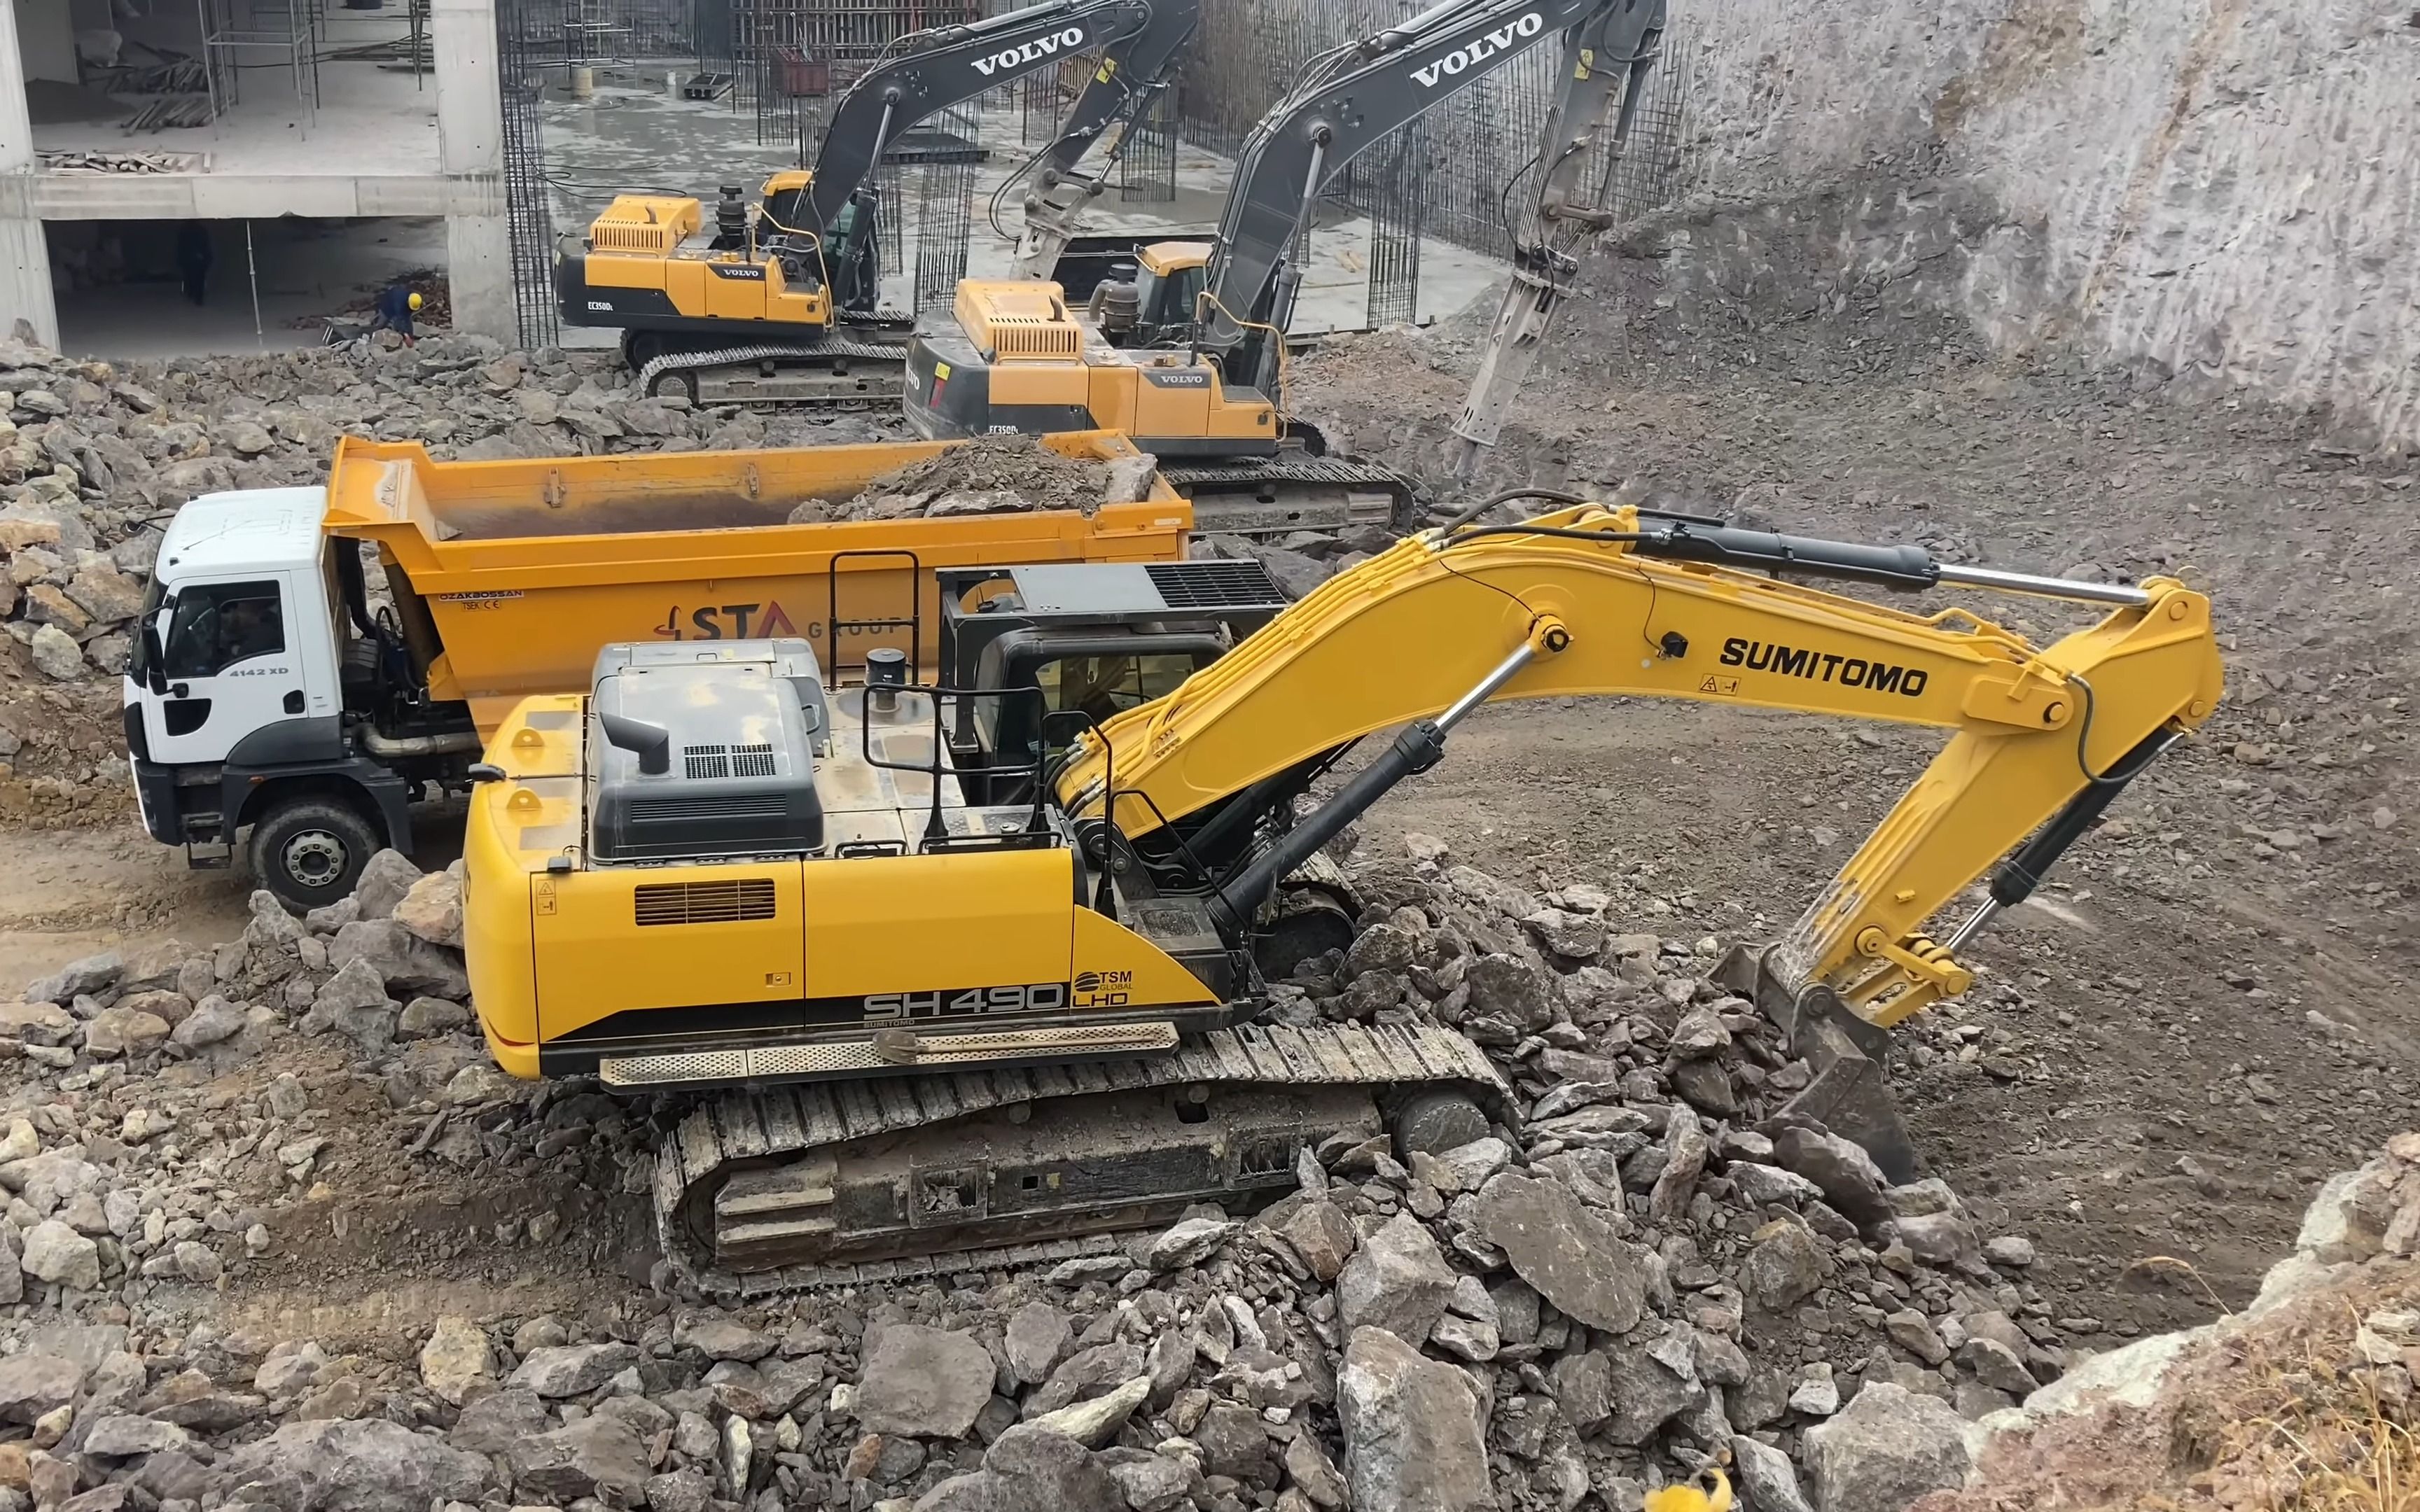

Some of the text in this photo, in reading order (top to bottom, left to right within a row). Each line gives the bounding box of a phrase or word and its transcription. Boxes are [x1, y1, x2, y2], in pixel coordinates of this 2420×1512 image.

[971, 27, 1084, 76] VOLVO
[1410, 13, 1543, 88] VOLVO
[723, 269, 759, 277] VOLVO
[1160, 375, 1203, 384] VOLVO
[230, 668, 266, 677] 4142
[1719, 637, 1928, 697] SUMITOMO
[1099, 970, 1132, 983] TSM
[863, 983, 1064, 1021] SH 490
[1073, 993, 1128, 1007] LHD
